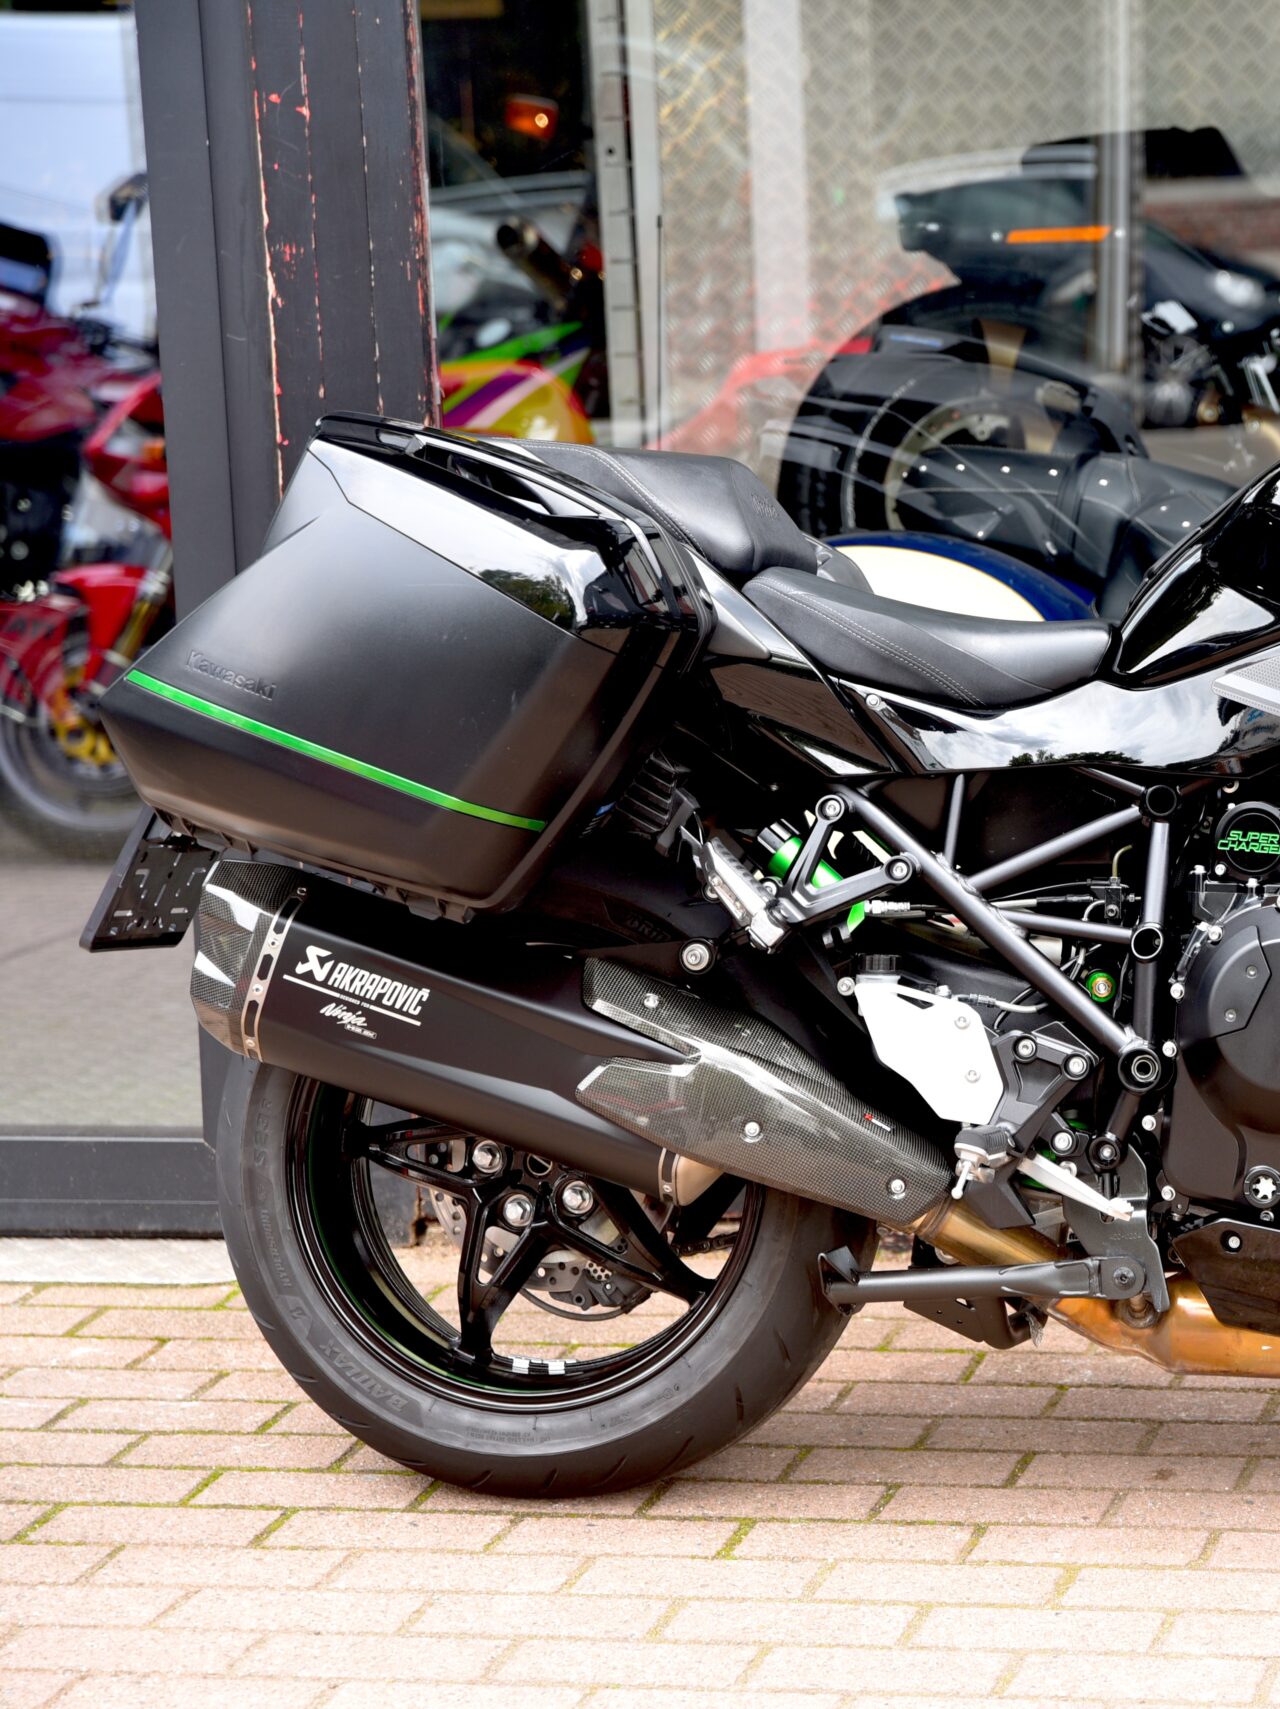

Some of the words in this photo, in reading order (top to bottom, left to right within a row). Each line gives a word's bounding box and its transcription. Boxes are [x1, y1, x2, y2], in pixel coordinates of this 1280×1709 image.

[184, 650, 276, 702] Kawasaki
[1227, 830, 1280, 844] SUPER
[327, 962, 431, 1016] AKRAPOVIČ
[320, 1002, 368, 1025] Ninja
